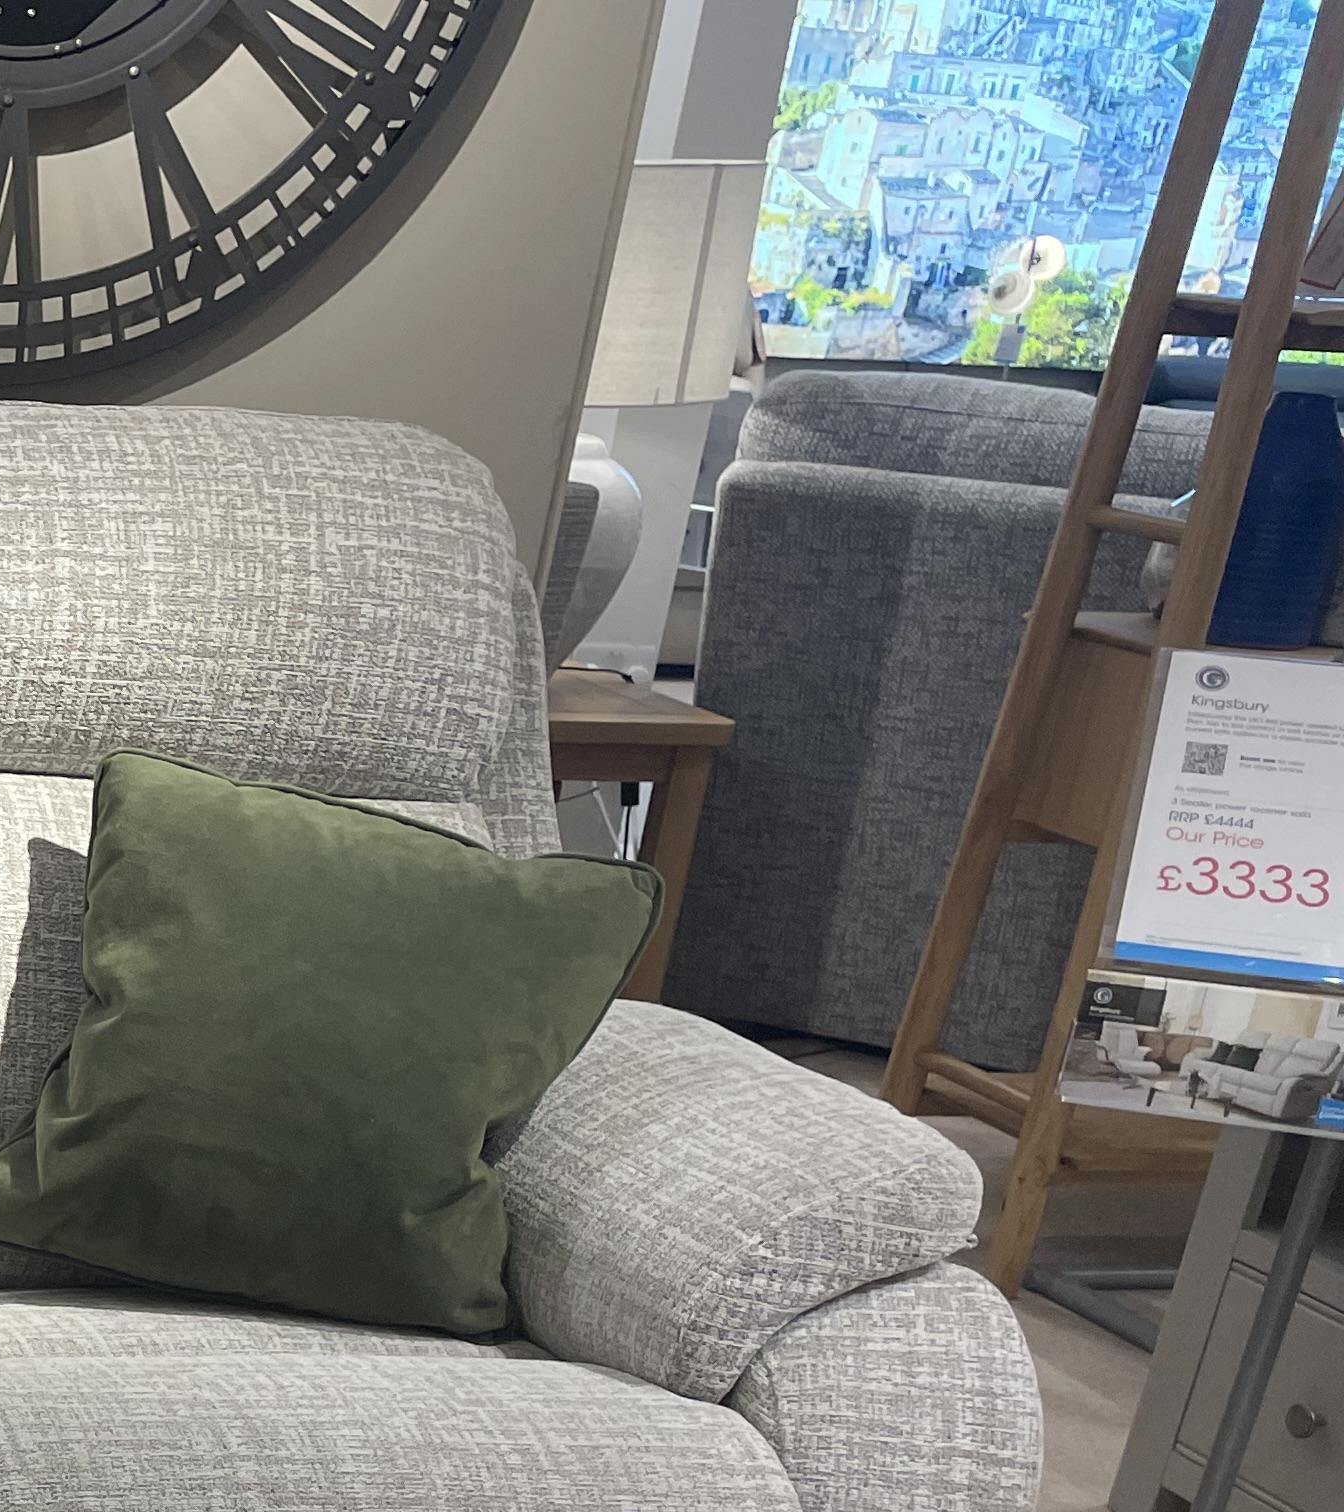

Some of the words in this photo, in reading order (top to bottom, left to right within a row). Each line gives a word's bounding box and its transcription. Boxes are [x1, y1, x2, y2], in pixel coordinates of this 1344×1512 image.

[1192, 694, 1270, 713] Kingsbury
[1169, 810, 1200, 823] RRP
[1204, 814, 1254, 829] £4444
[1166, 826, 1206, 843] Our
[1212, 831, 1264, 850] Price
[1156, 856, 1330, 908] £3333
